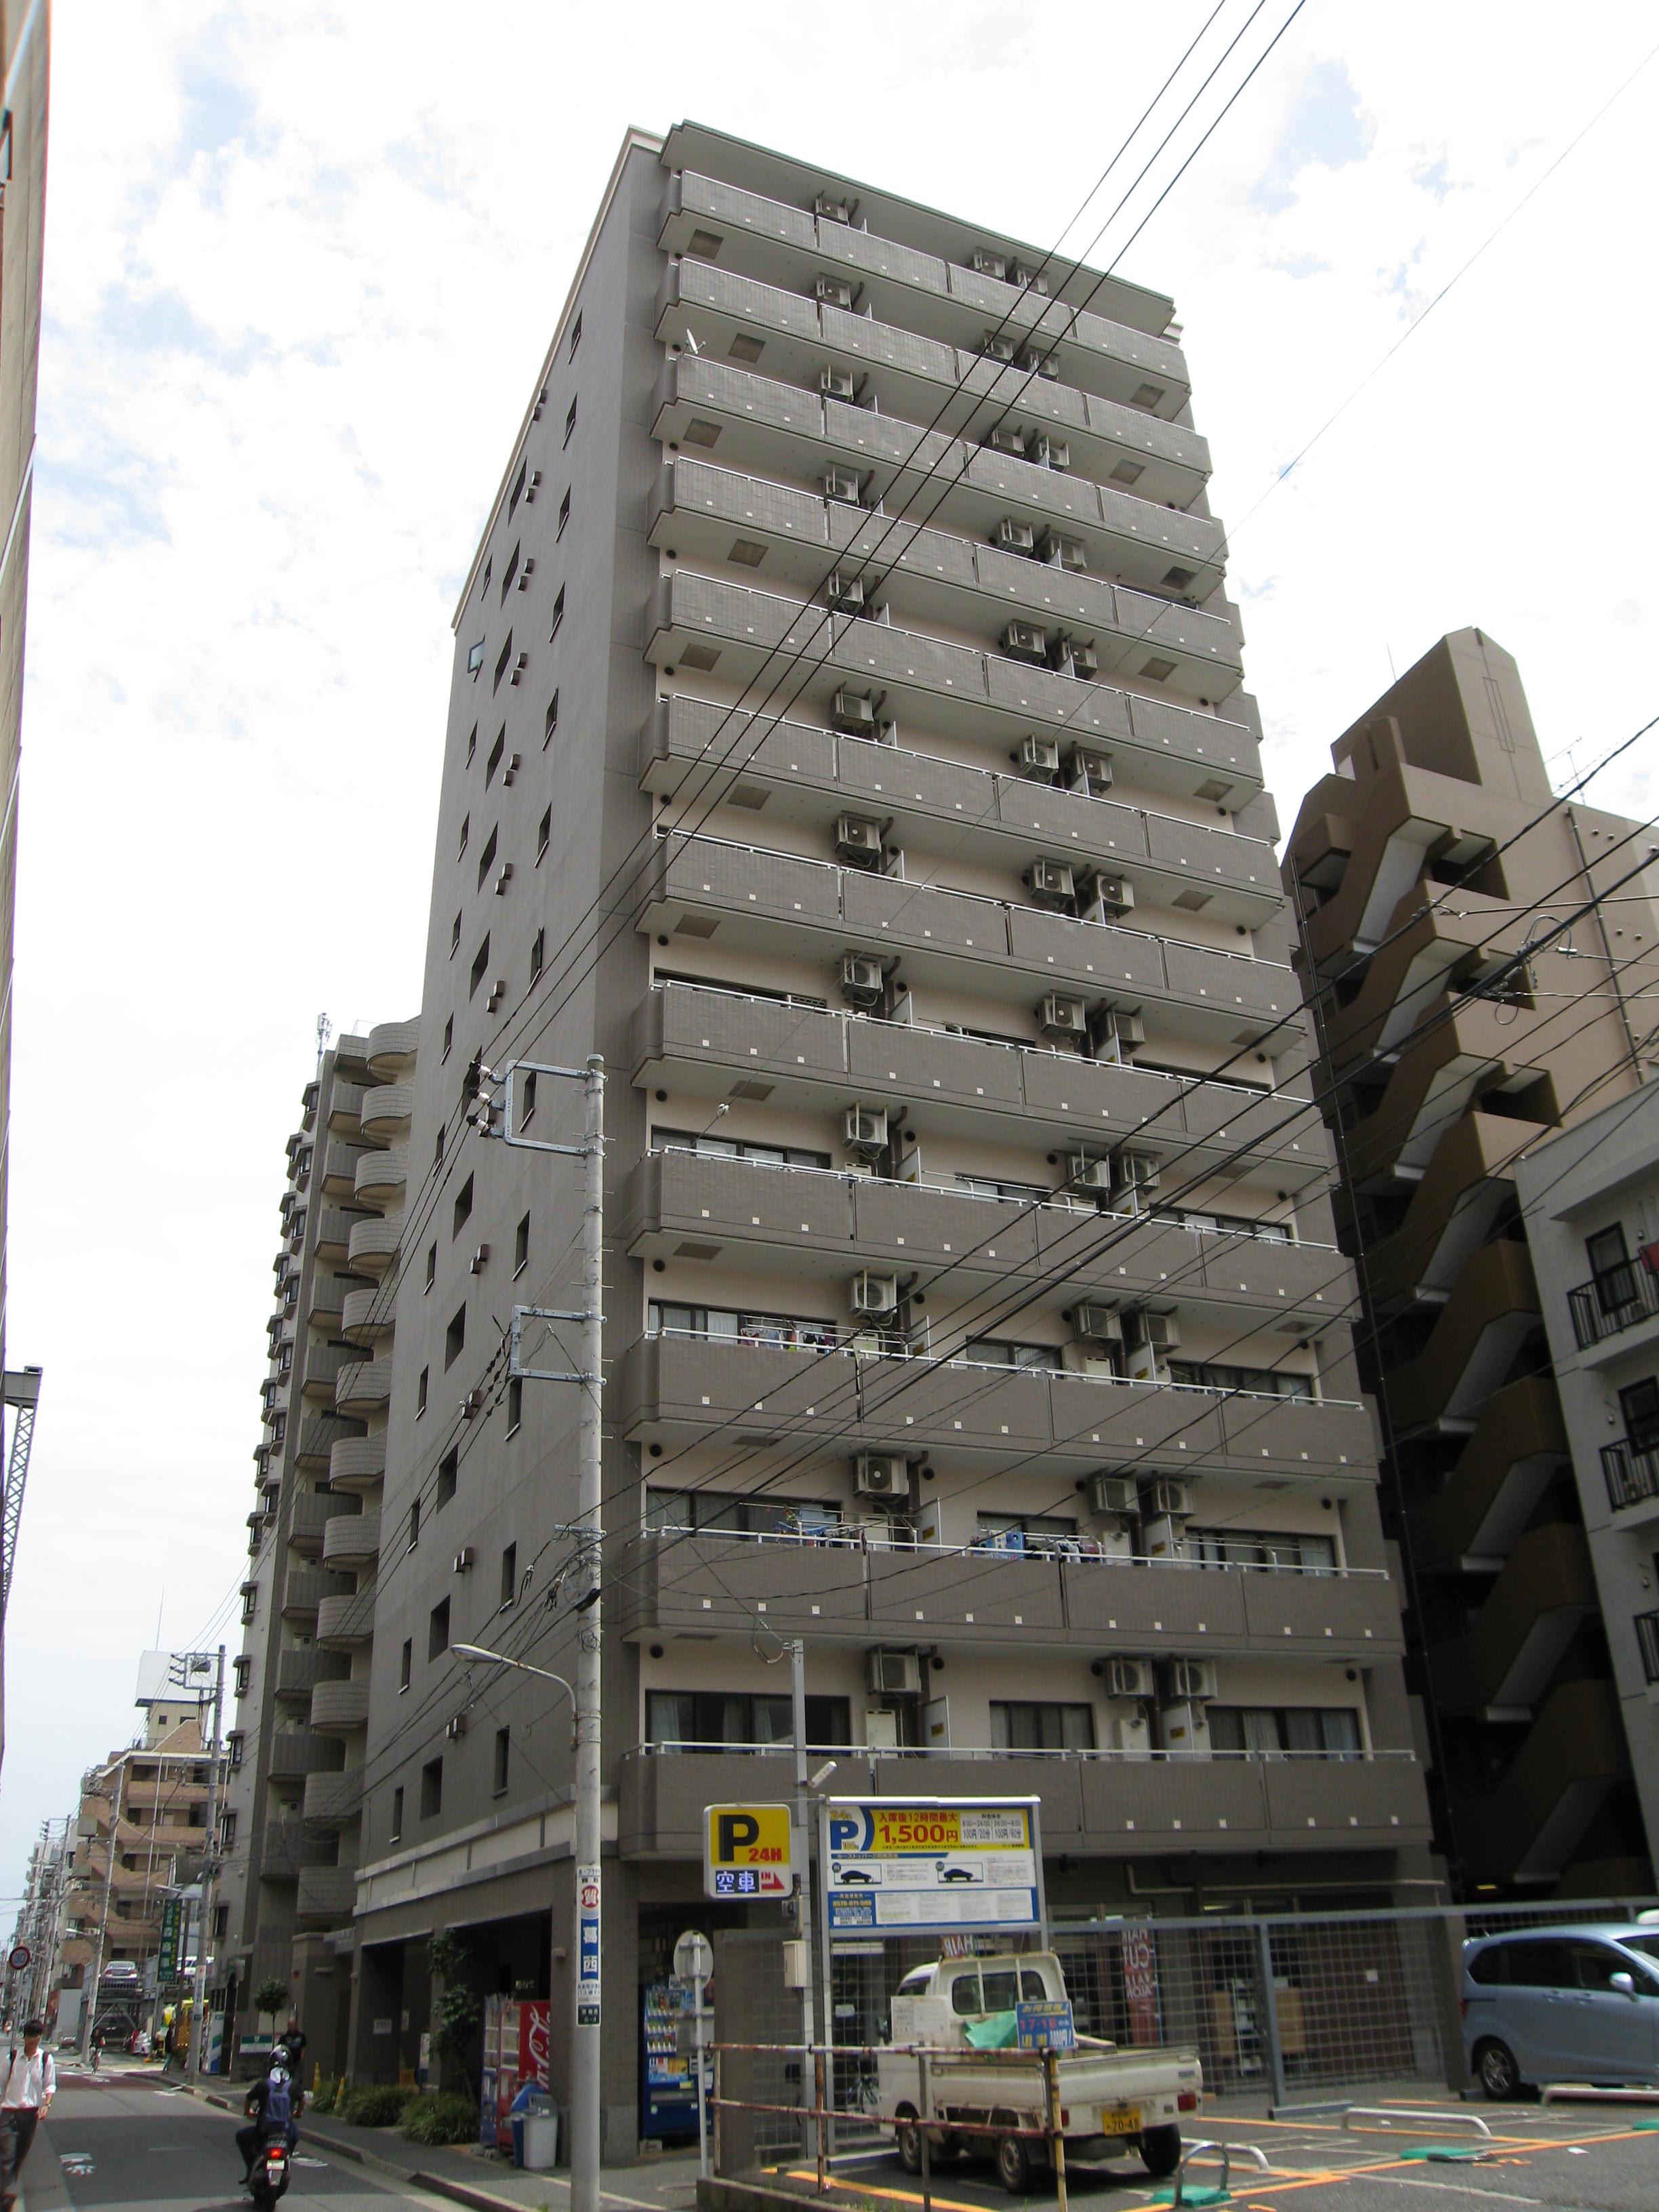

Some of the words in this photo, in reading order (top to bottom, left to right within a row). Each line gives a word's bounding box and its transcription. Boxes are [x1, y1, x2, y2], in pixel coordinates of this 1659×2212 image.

[879, 1811, 958, 1823] 入庫後12時間最大
[719, 1814, 759, 1862] P
[830, 1820, 859, 1850] P
[879, 1824, 958, 1845] 1,500円
[749, 1848, 782, 1862] 24H
[716, 1870, 755, 1893] 空車
[761, 1872, 771, 1880] IN
